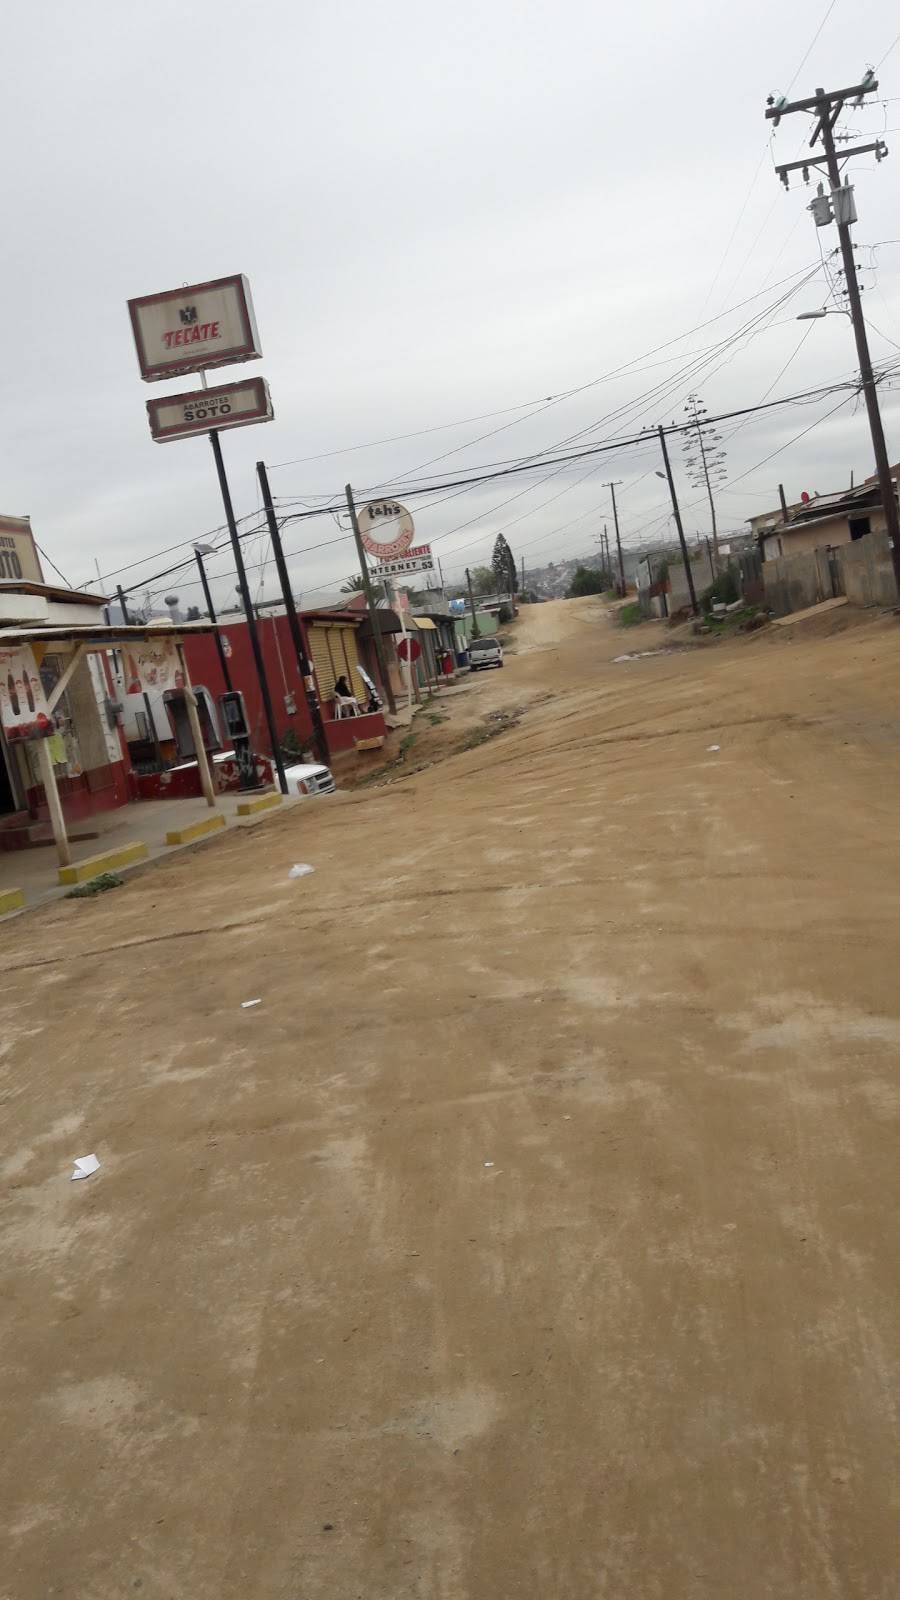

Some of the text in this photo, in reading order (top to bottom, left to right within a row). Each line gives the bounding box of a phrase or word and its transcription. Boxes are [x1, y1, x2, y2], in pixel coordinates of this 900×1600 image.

[164, 321, 220, 349] TECATE
[183, 397, 229, 411] ABARROTES
[184, 404, 231, 421] SOTO
[370, 561, 433, 575] NTERNET 53
